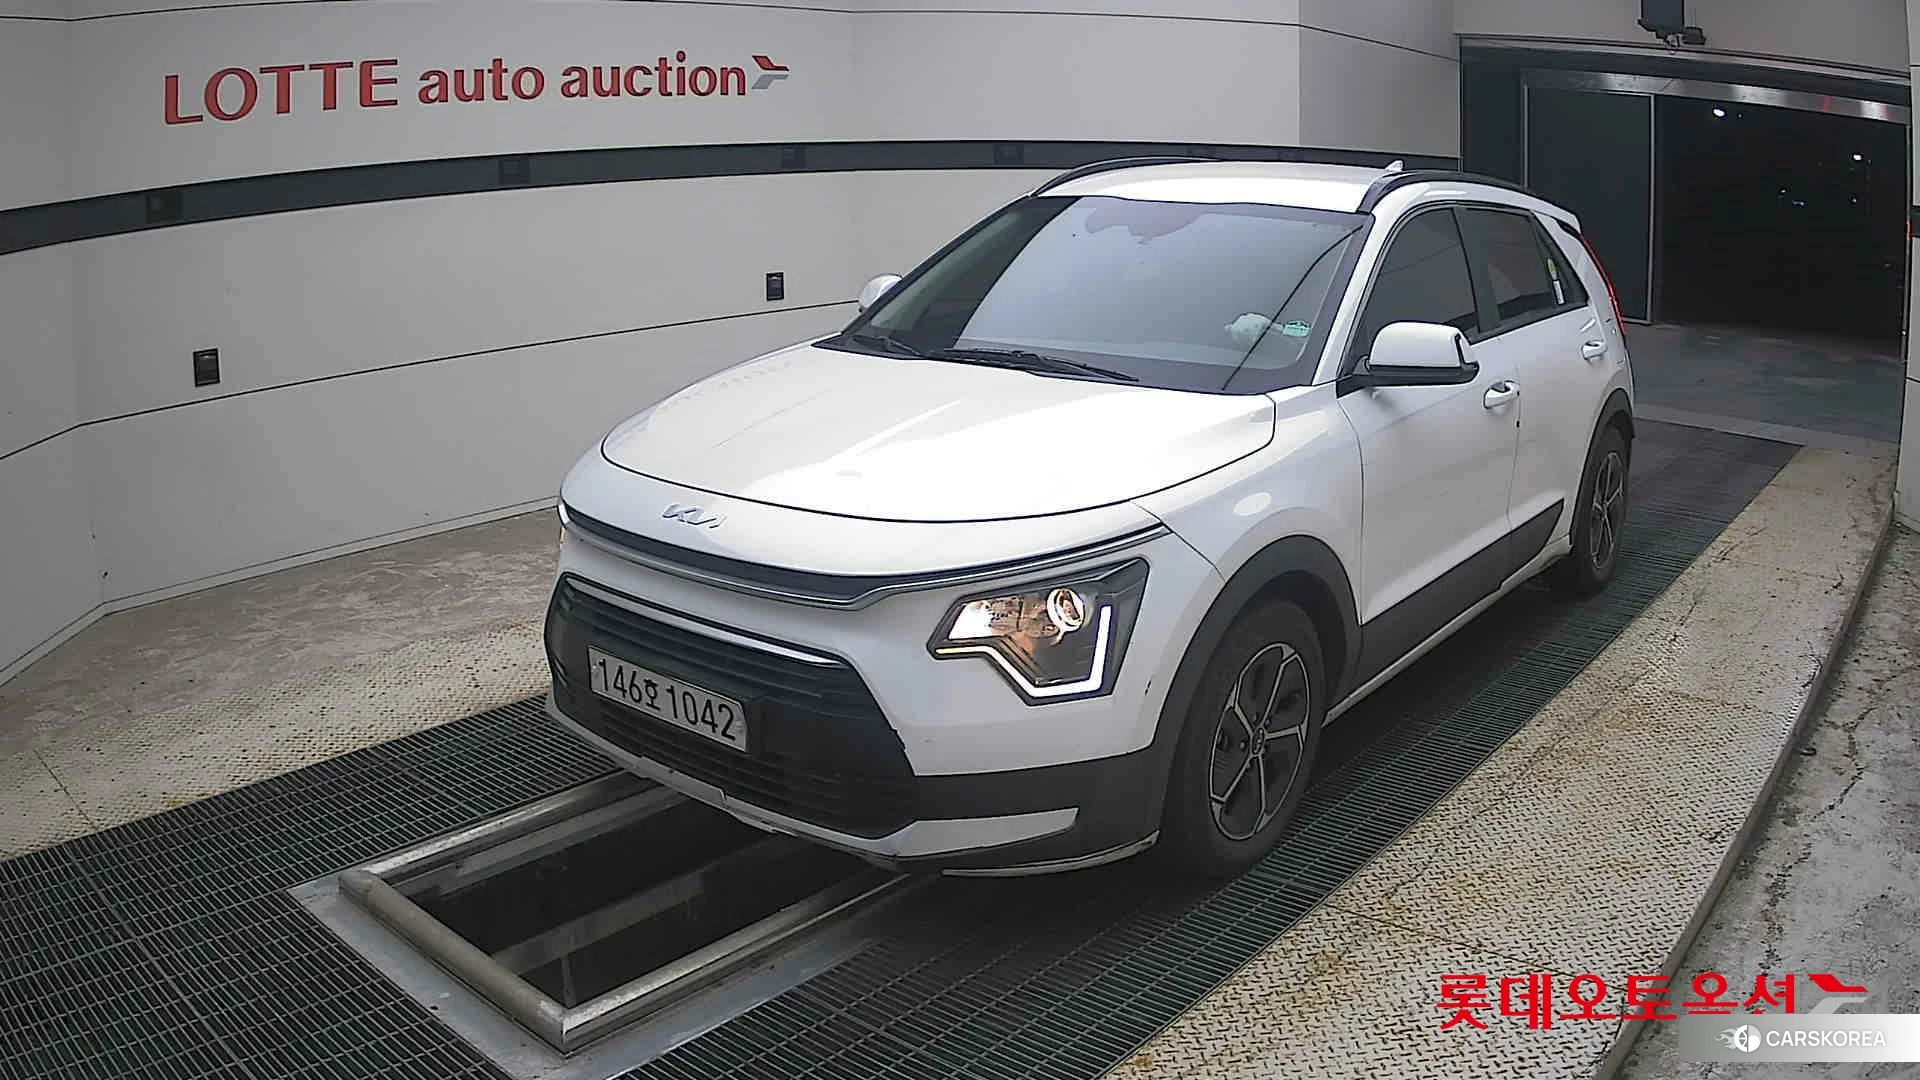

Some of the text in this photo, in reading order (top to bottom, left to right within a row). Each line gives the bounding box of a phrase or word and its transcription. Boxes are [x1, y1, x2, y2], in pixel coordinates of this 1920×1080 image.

[164, 50, 747, 126] LOTTE auto auction
[666, 684, 736, 741] 1042
